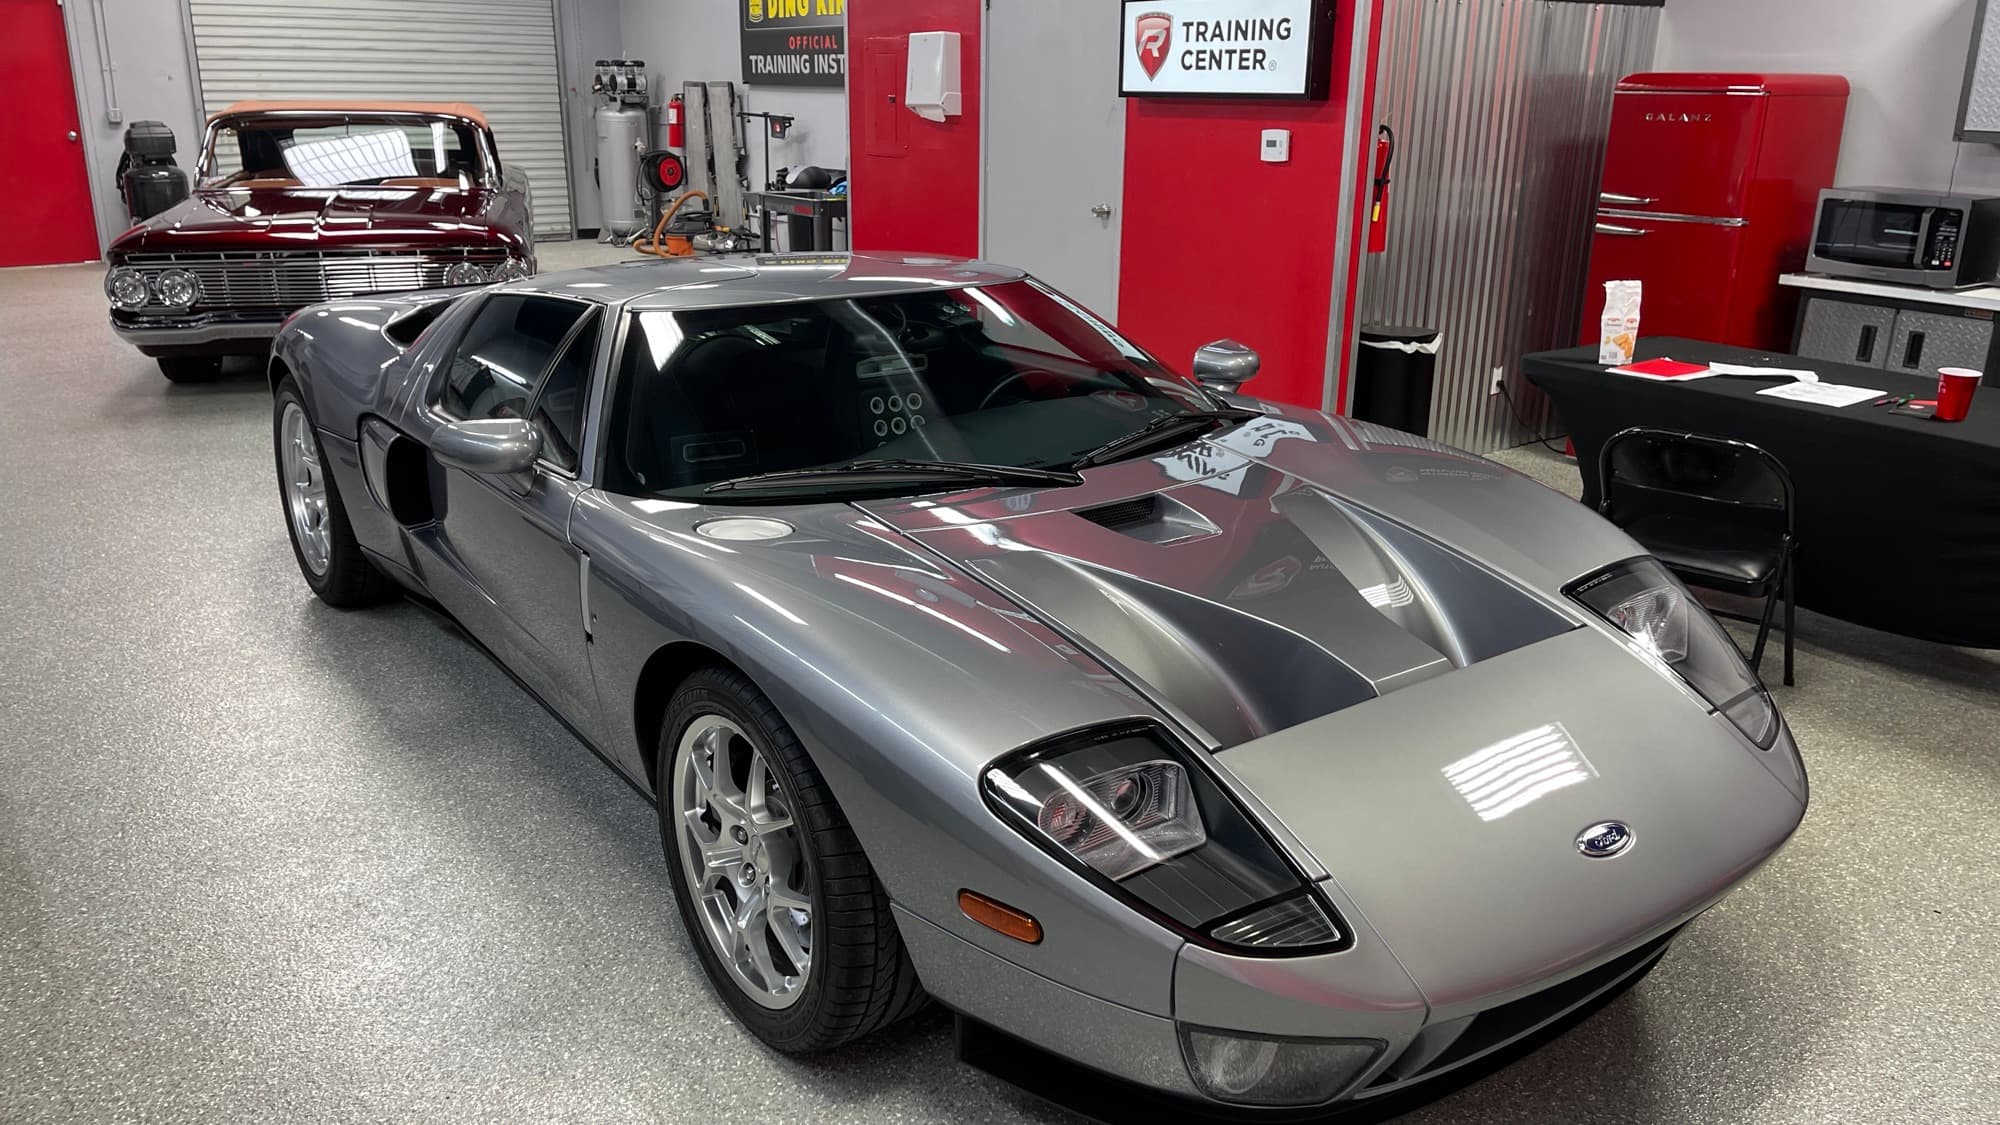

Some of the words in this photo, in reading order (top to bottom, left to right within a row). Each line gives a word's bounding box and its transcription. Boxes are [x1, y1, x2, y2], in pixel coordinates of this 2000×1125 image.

[1182, 18, 1291, 43] TRAINING
[788, 35, 838, 49] OFFICIAL
[749, 54, 810, 74] TRAINING
[1645, 112, 1712, 122] GALANZ
